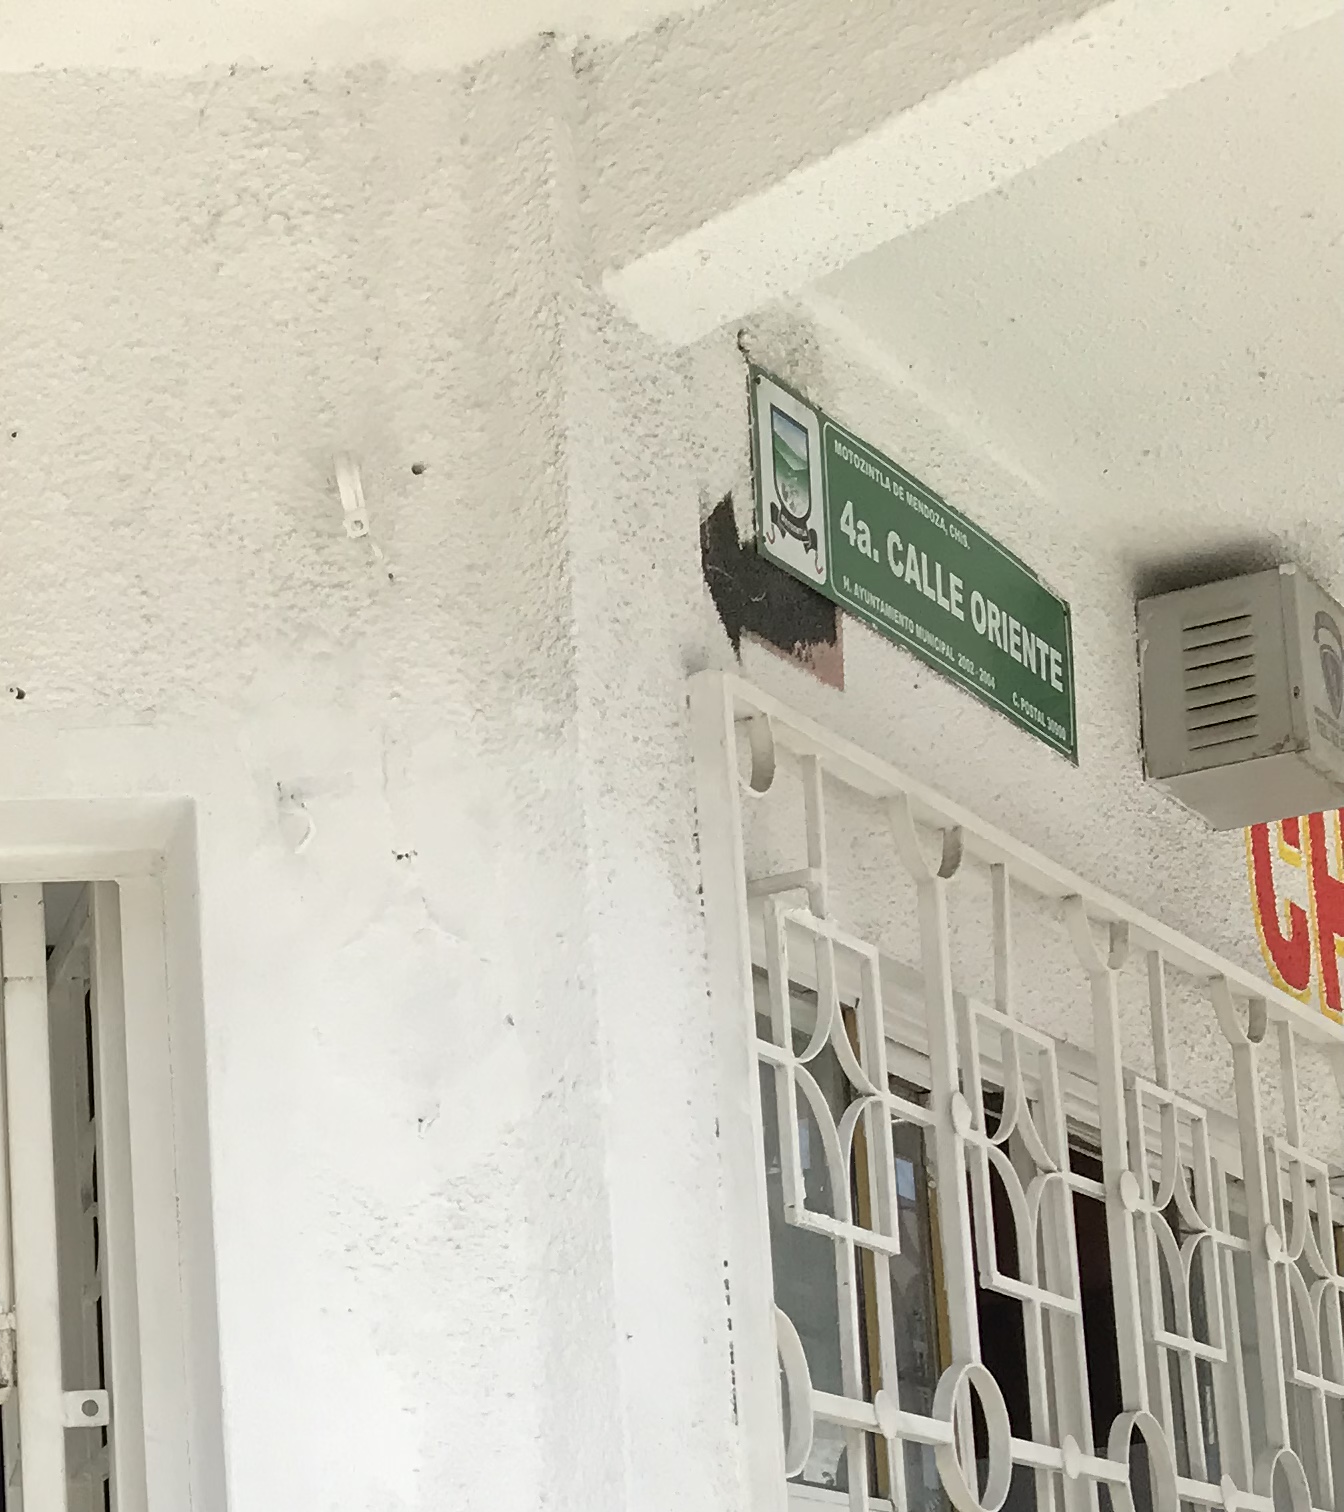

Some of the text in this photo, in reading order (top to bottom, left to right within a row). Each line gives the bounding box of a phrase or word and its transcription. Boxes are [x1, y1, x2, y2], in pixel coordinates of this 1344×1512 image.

[834, 439, 971, 550] MOTOZINTLA DE MENDOZA, CHIS.
[840, 500, 1064, 693] 4a. CALLE ORIENTE
[842, 575, 853, 593] H.
[853, 583, 915, 634] AYUNTAMIENTO
[915, 624, 956, 662] MUNICIPAL
[1020, 697, 1047, 727] POSTAL
